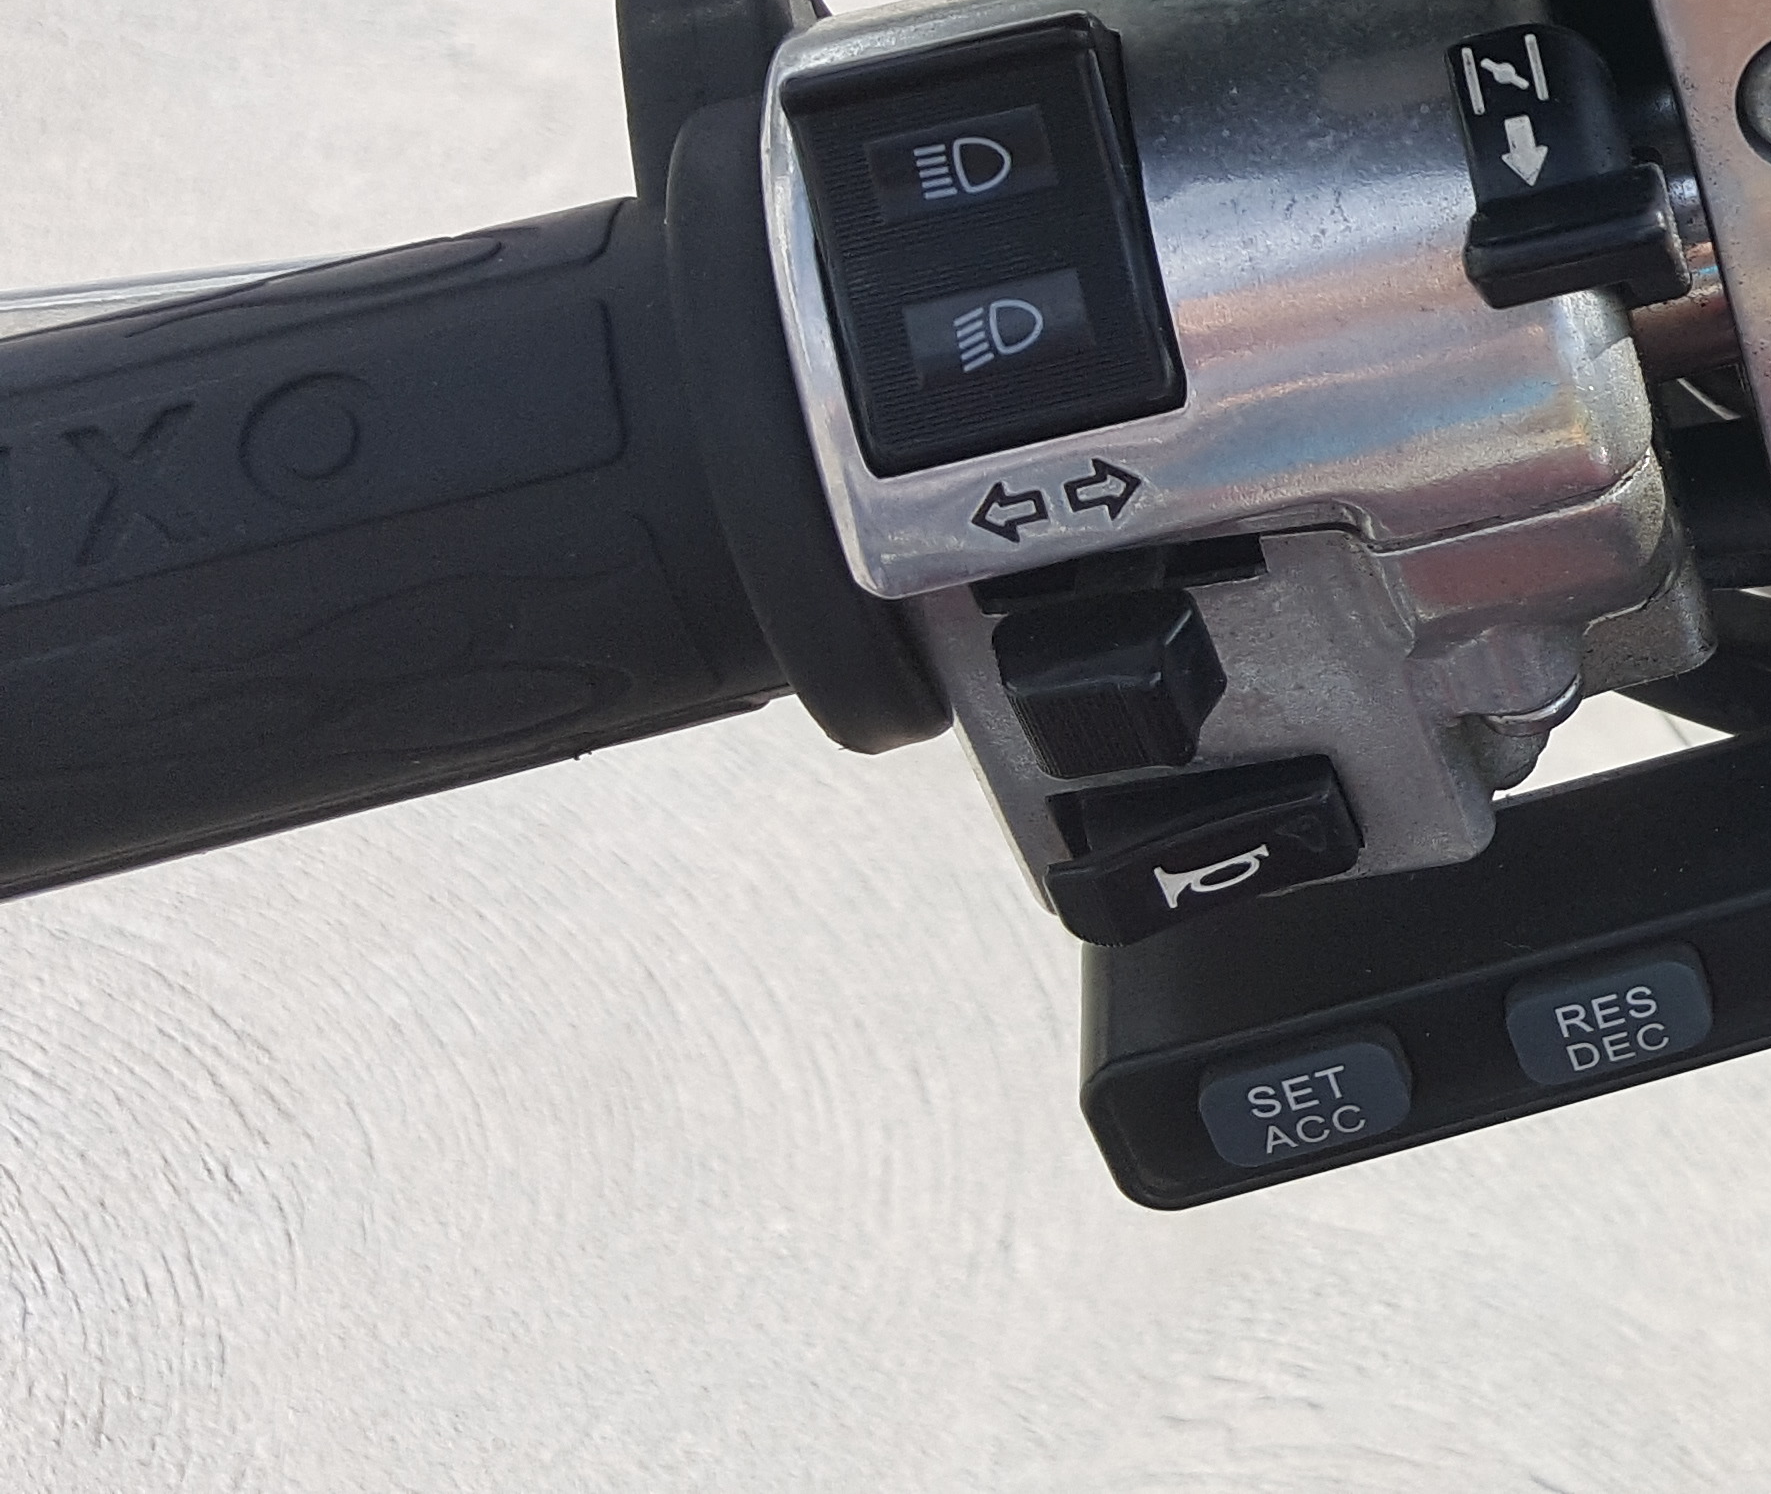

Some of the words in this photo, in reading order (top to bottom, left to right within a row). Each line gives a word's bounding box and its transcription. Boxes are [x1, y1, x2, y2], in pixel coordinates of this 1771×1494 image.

[1554, 984, 1658, 1040] RES
[1566, 1021, 1671, 1073] DEC
[1246, 1065, 1346, 1120] SET
[1264, 1103, 1366, 1155] ACC
